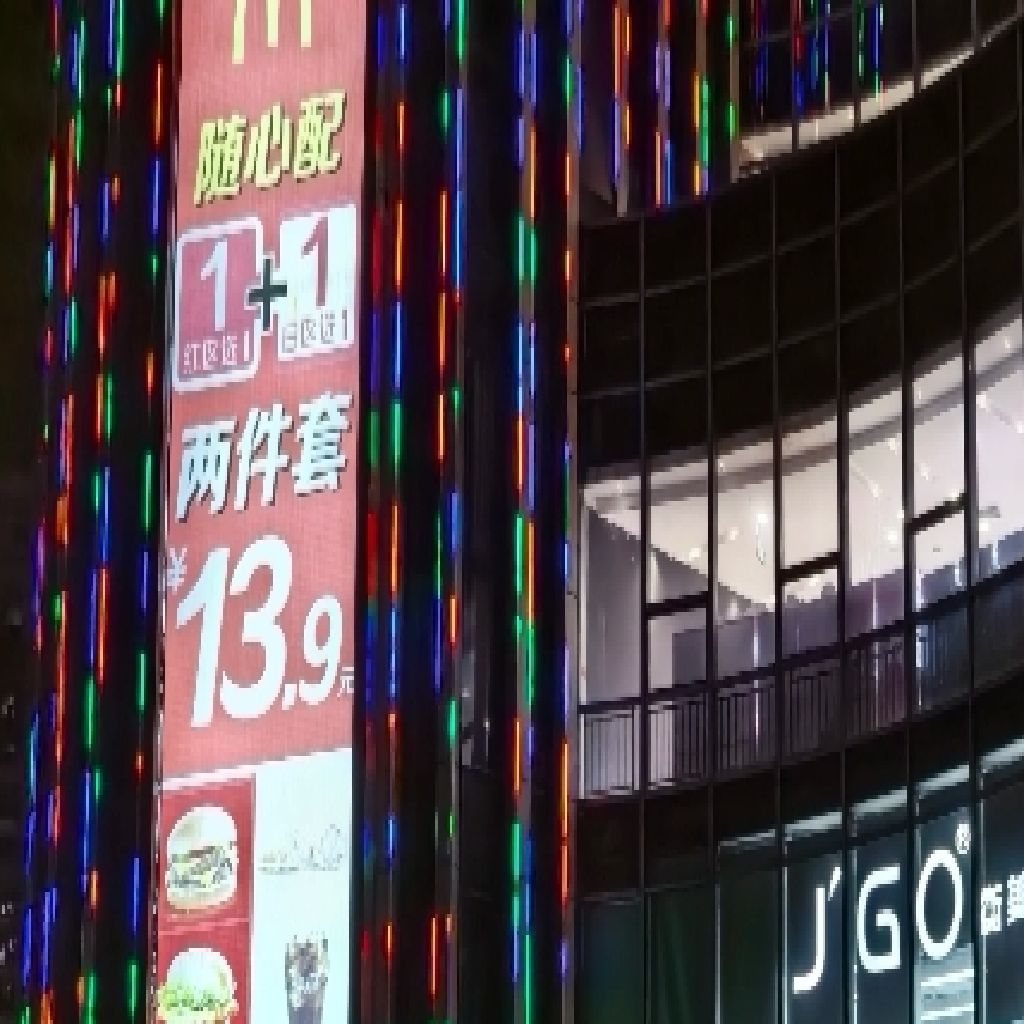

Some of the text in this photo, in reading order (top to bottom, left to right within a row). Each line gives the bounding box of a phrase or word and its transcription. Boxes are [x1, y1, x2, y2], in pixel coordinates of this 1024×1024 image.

[194, 90, 346, 206] 随心配
[176, 391, 352, 522] 两件套
